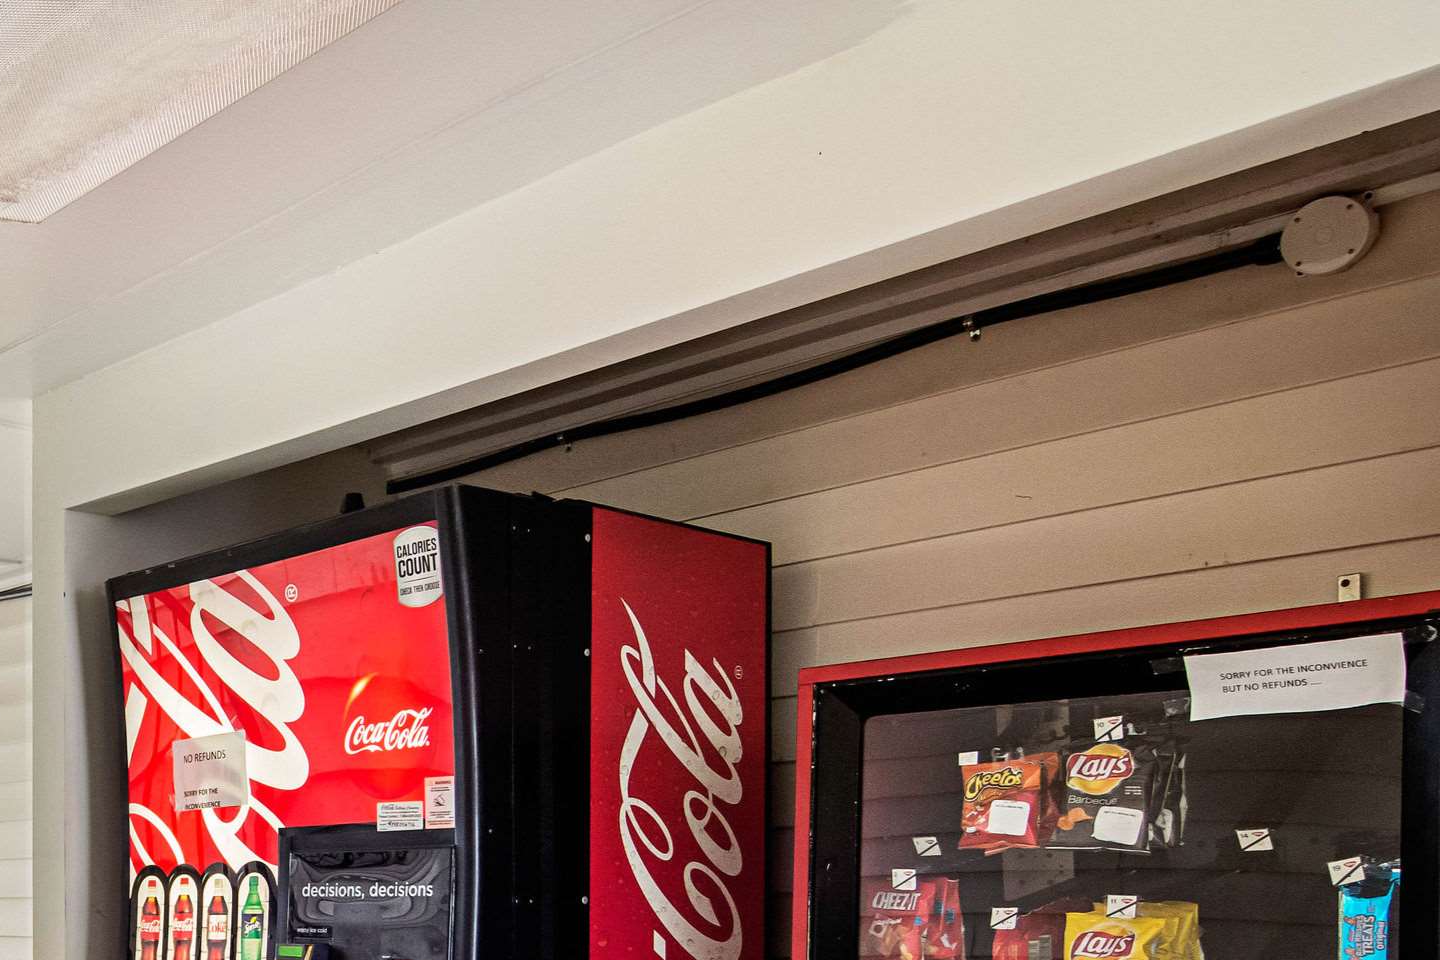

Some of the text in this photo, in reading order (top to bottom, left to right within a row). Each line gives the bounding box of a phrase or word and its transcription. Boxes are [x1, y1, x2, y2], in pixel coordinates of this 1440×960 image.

[397, 538, 437, 558] CALORIES
[398, 553, 437, 578] COUNT
[1220, 659, 1368, 681] SORRY FOR THE INCONVIENCE
[1222, 683, 1241, 693] BUT
[1244, 683, 1259, 691] NO
[1262, 679, 1308, 689] REFUNDS
[344, 707, 434, 755] Coca-Cola
[183, 750, 226, 763] NO REFUNDS
[965, 768, 1023, 799] Cheetos
[1067, 795, 1118, 805] Barbecue
[302, 882, 434, 899] decisions, decisions
[1363, 916, 1375, 954] TREATS
